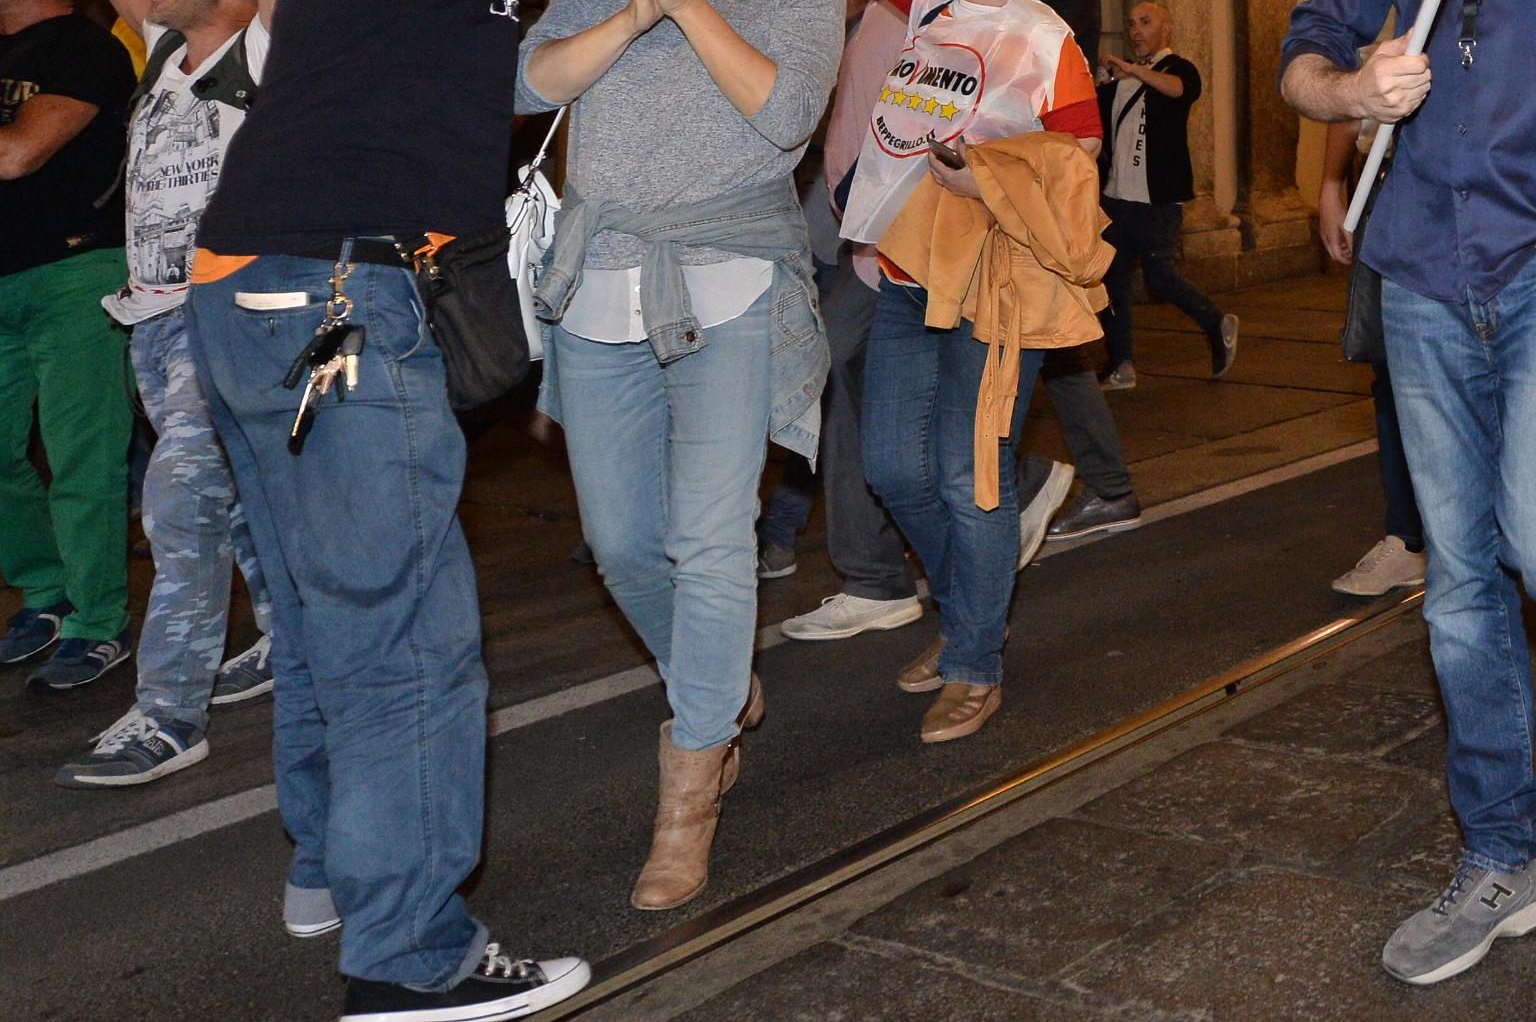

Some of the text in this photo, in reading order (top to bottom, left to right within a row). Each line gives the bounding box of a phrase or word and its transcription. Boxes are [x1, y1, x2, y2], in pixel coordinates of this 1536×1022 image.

[876, 116, 936, 150] BEPPEGRILLO.IT
[161, 157, 218, 177] NEW YORK
[168, 168, 218, 189] THIRTIES
